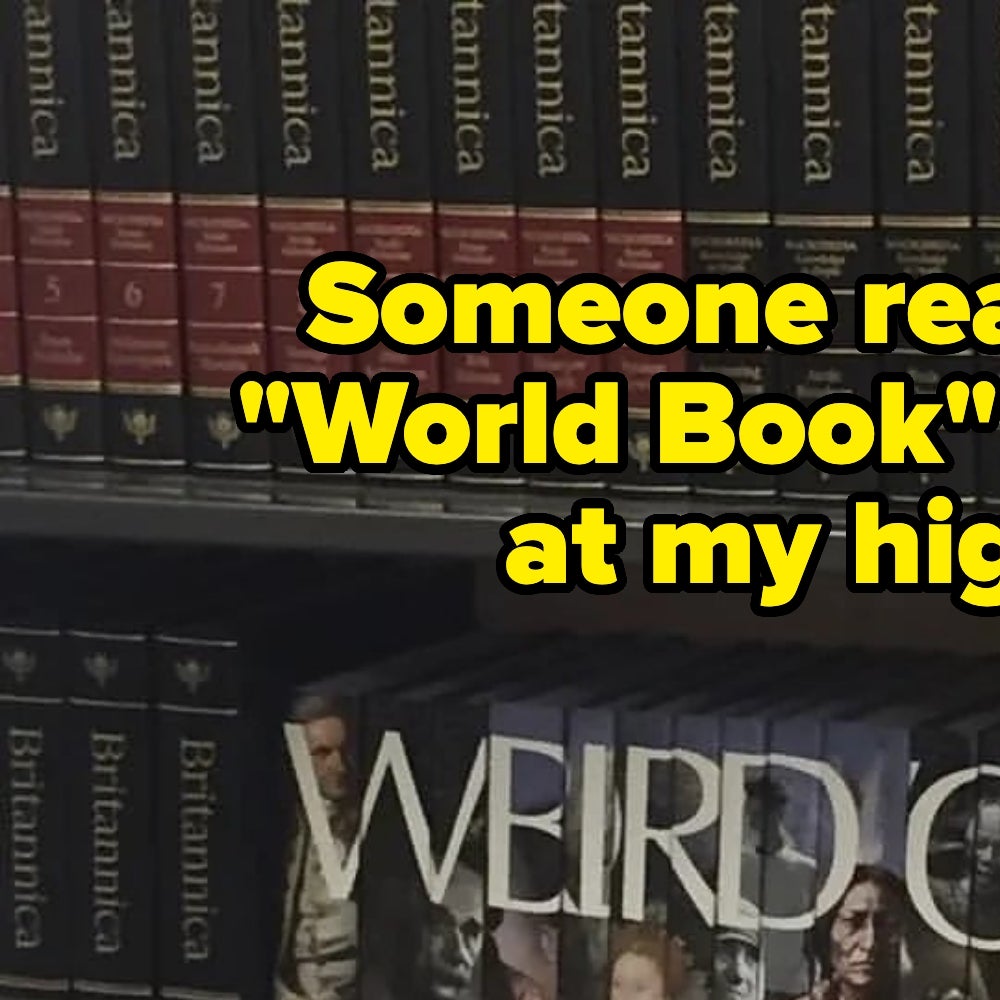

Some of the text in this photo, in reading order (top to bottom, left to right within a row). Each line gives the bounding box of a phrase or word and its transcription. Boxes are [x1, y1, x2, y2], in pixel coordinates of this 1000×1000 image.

[44, 275, 61, 303] 5
[123, 280, 144, 309] 6
[9, 728, 46, 950] Britannica
[90, 732, 129, 954] Britannica
[179, 739, 219, 963] Britannica
[283, 722, 861, 930] WEIRD
